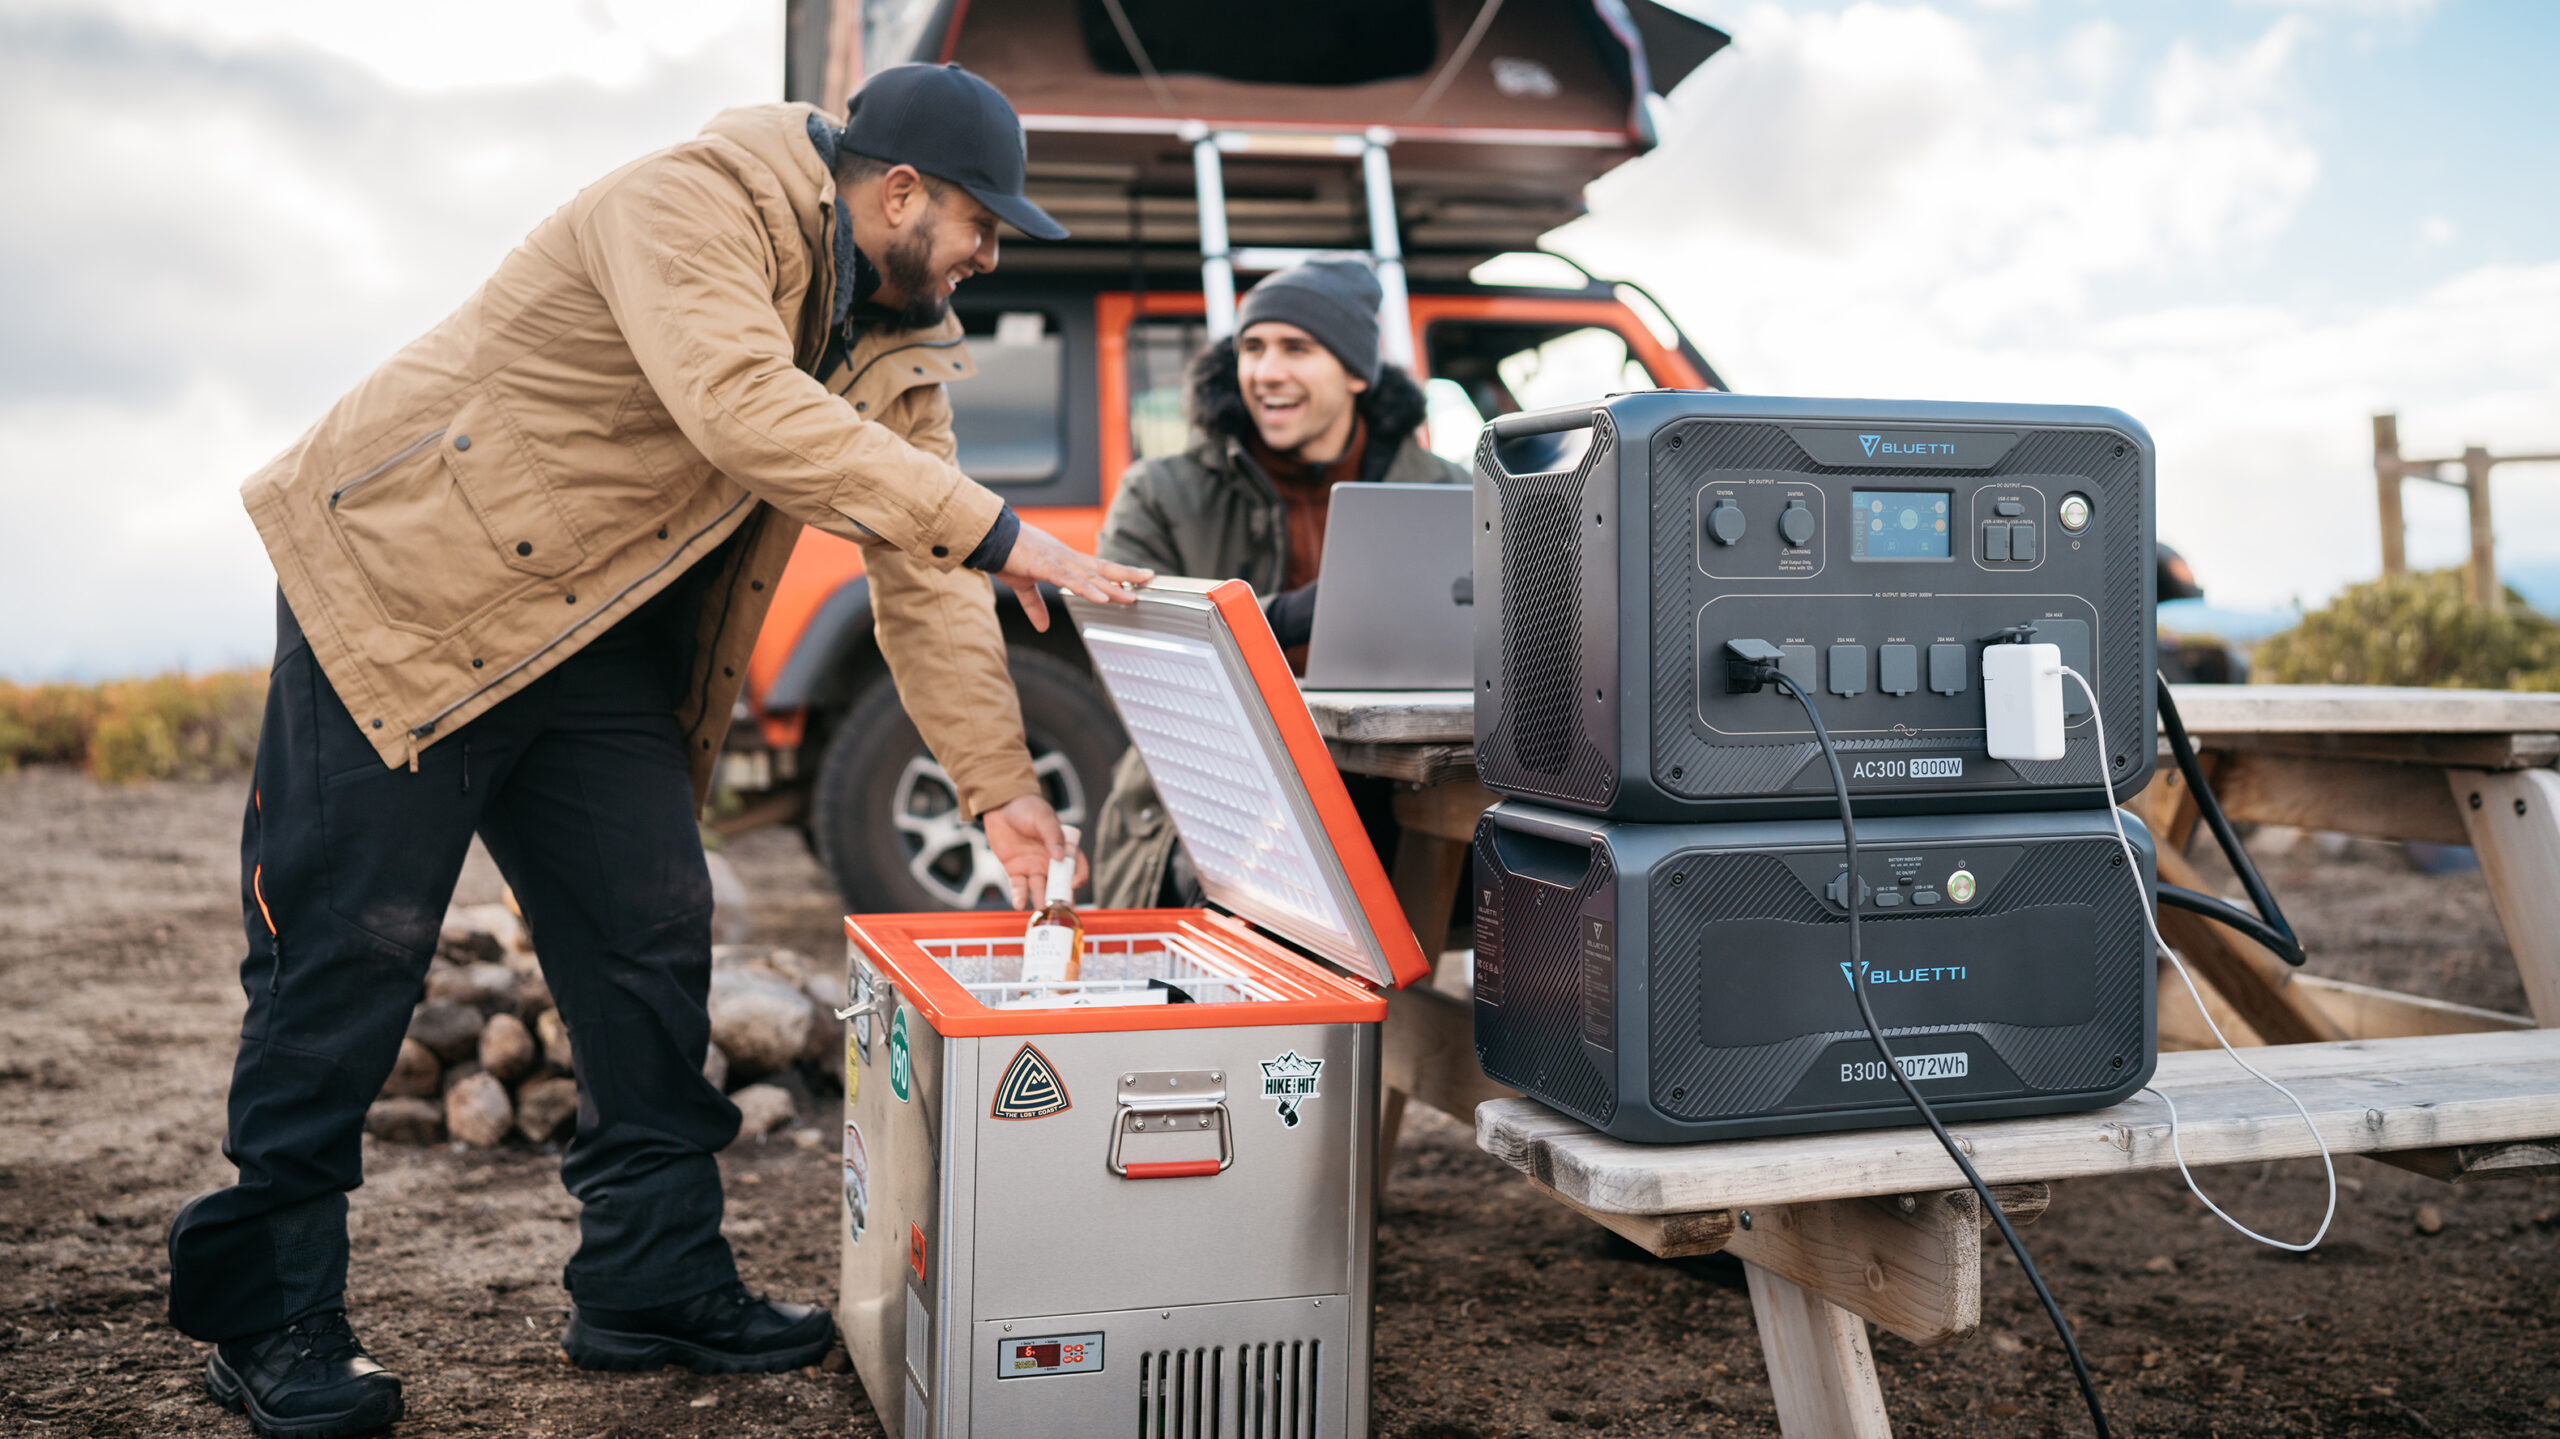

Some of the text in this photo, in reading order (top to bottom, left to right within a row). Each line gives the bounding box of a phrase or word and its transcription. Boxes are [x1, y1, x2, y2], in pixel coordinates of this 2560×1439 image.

[1882, 443, 1955, 454] BLUETTI
[1853, 760, 1960, 778] AC300 3000W
[1586, 940, 1610, 953] BLUETTI
[1871, 966, 1966, 984] BLUETTI
[891, 1041, 907, 1090] 190
[1841, 1061, 1887, 1082] B300
[1265, 1078, 1316, 1094] HIKE HIT
[1038, 1107, 1058, 1116] COAST
